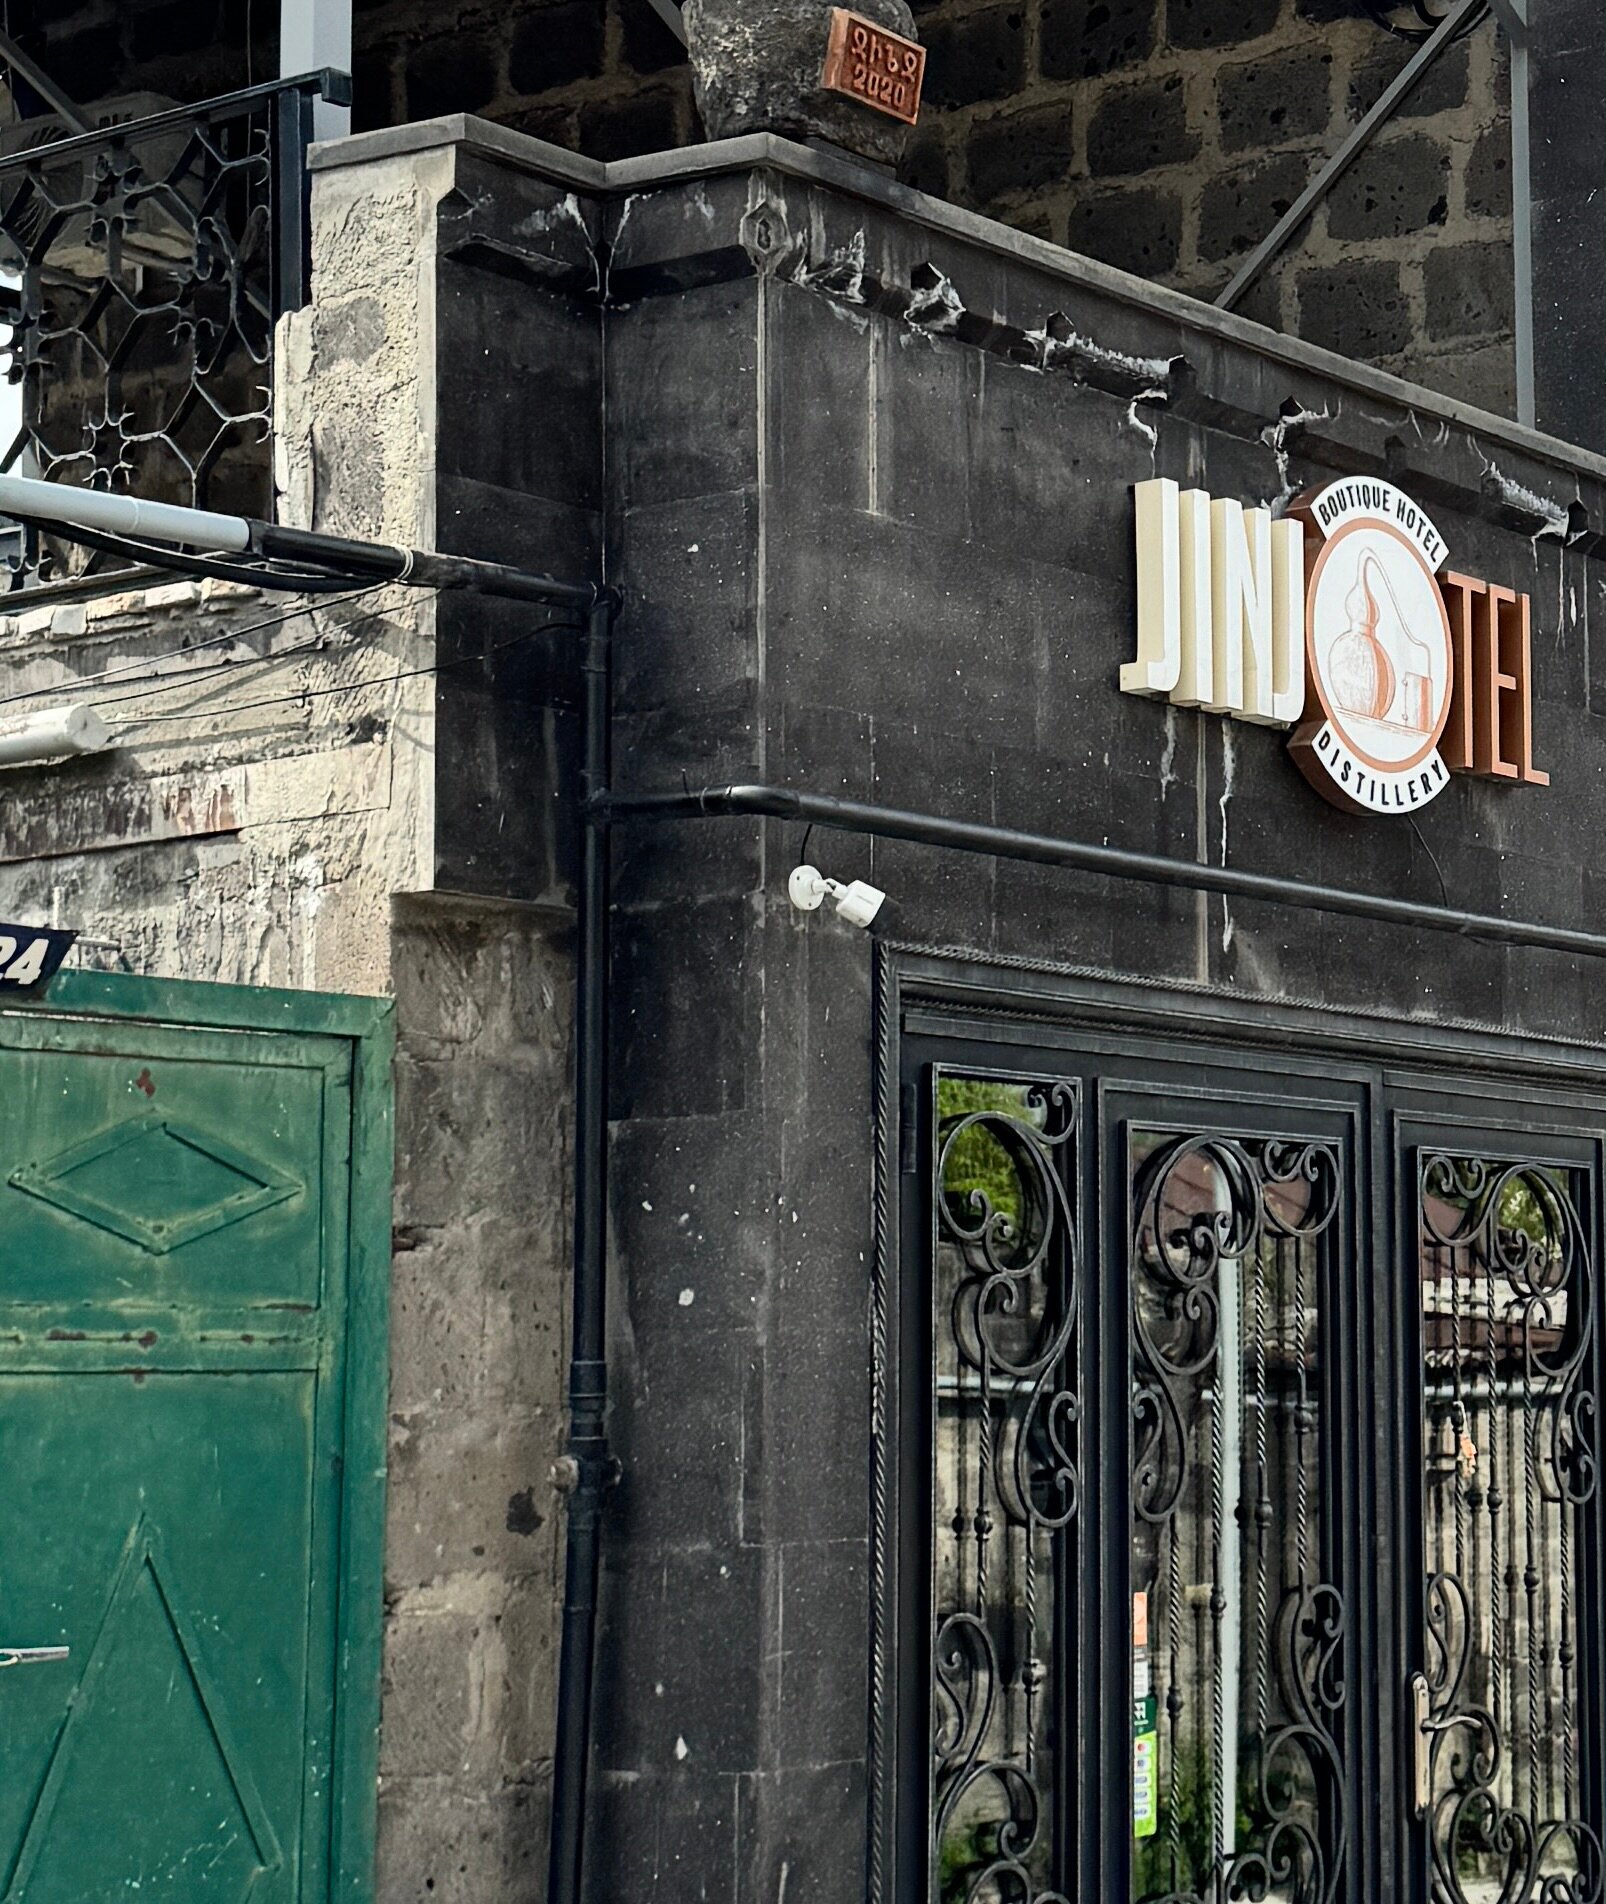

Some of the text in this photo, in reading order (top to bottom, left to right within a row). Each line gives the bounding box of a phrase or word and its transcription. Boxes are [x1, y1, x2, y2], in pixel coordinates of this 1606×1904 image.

[853, 63, 905, 107] 2020
[1318, 484, 1440, 563] BOUTIQUE HOTEL
[1318, 730, 1443, 806] DISTILLERY
